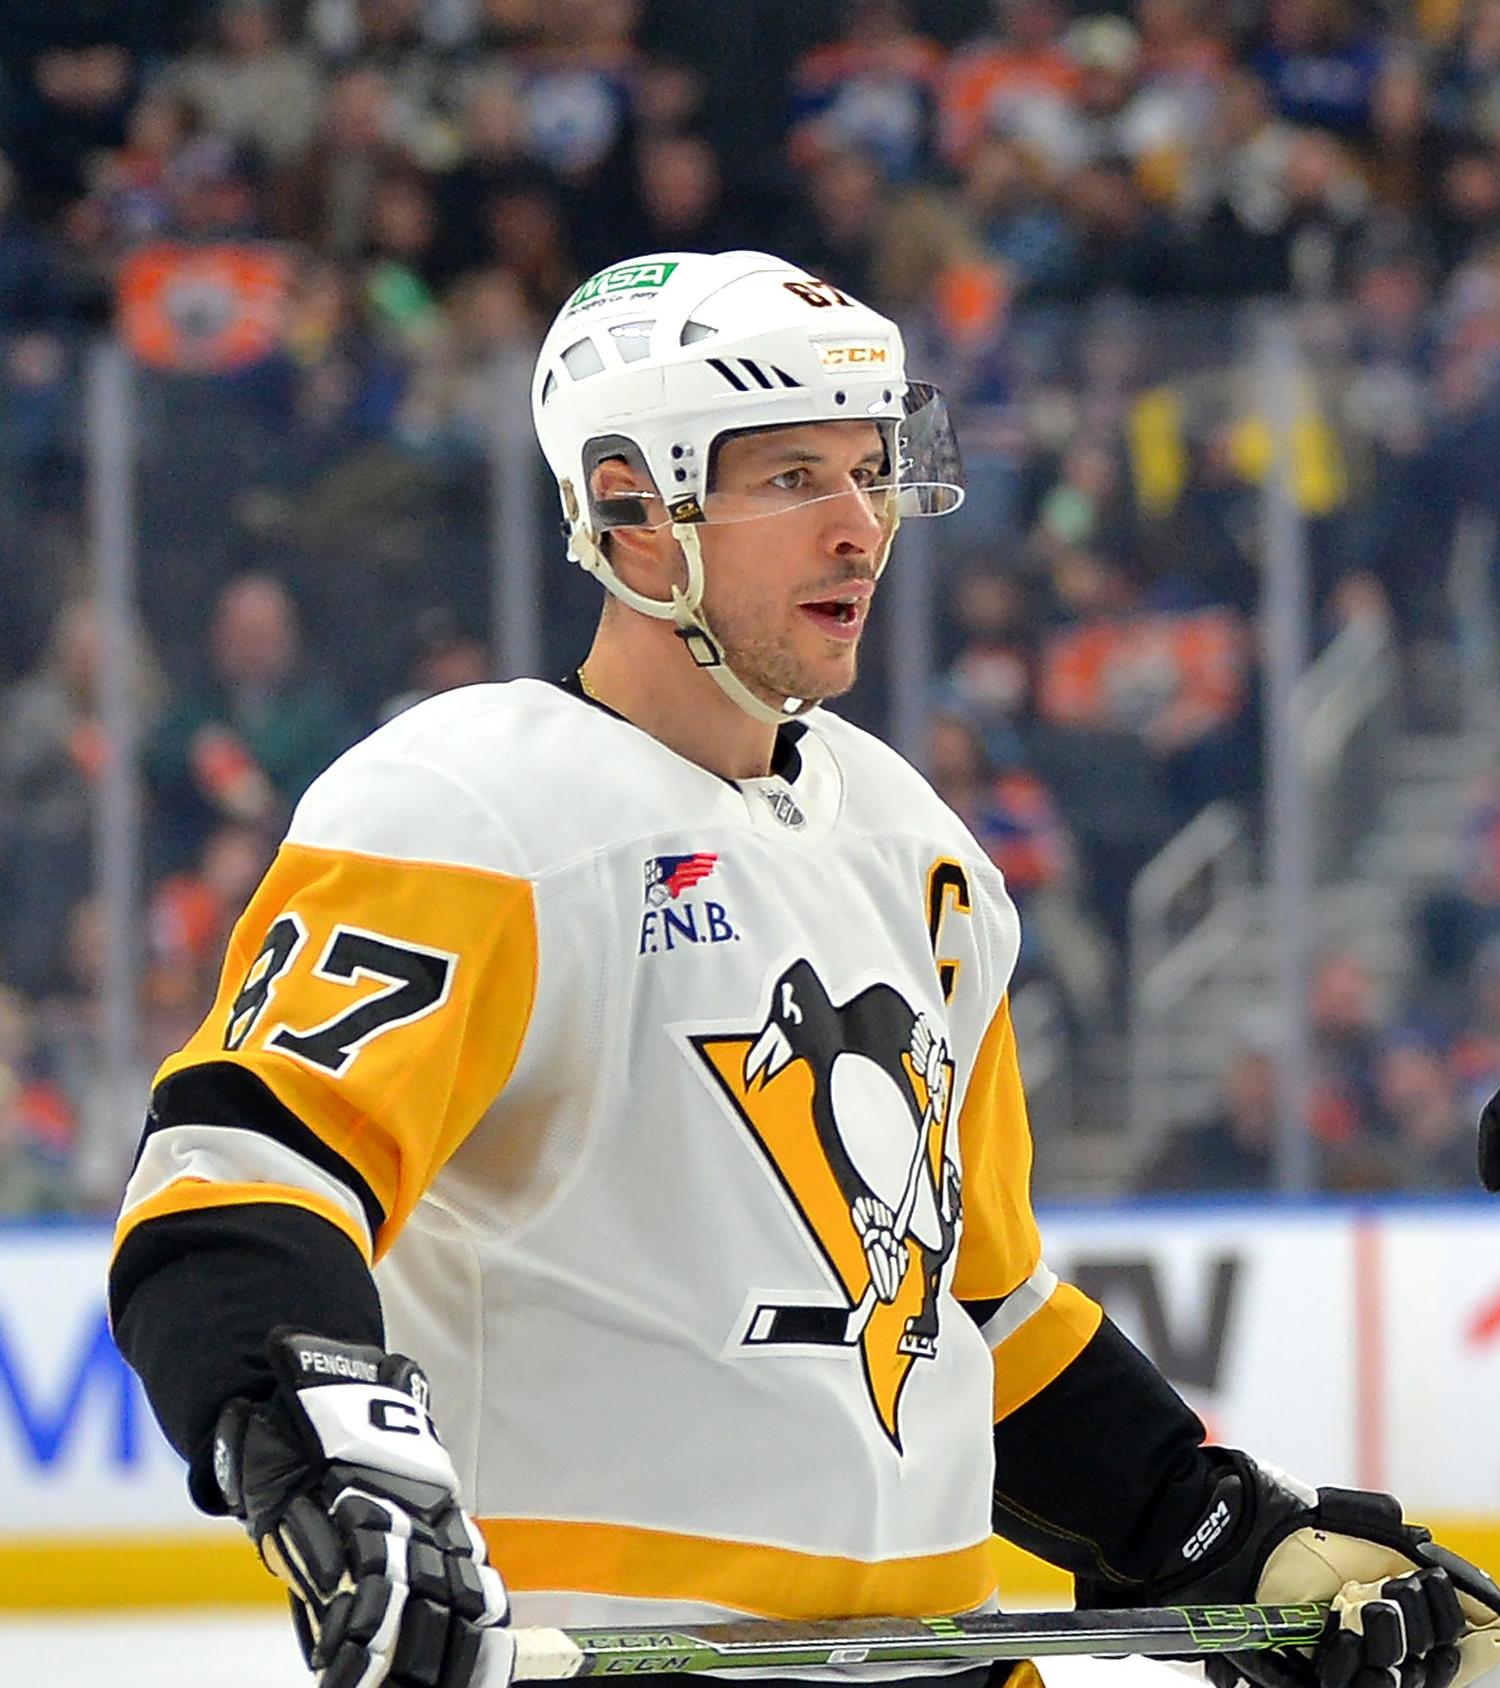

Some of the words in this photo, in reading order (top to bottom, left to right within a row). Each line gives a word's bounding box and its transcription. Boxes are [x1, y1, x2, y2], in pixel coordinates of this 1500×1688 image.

[571, 263, 672, 306] MSA
[823, 348, 885, 364] CCM
[640, 901, 740, 955] F.N.B.
[926, 856, 972, 1007] C
[223, 912, 459, 1080] 87
[300, 1350, 378, 1382] PENGUINS
[1182, 1500, 1228, 1558] CCM
[606, 1656, 690, 1672] CCM
